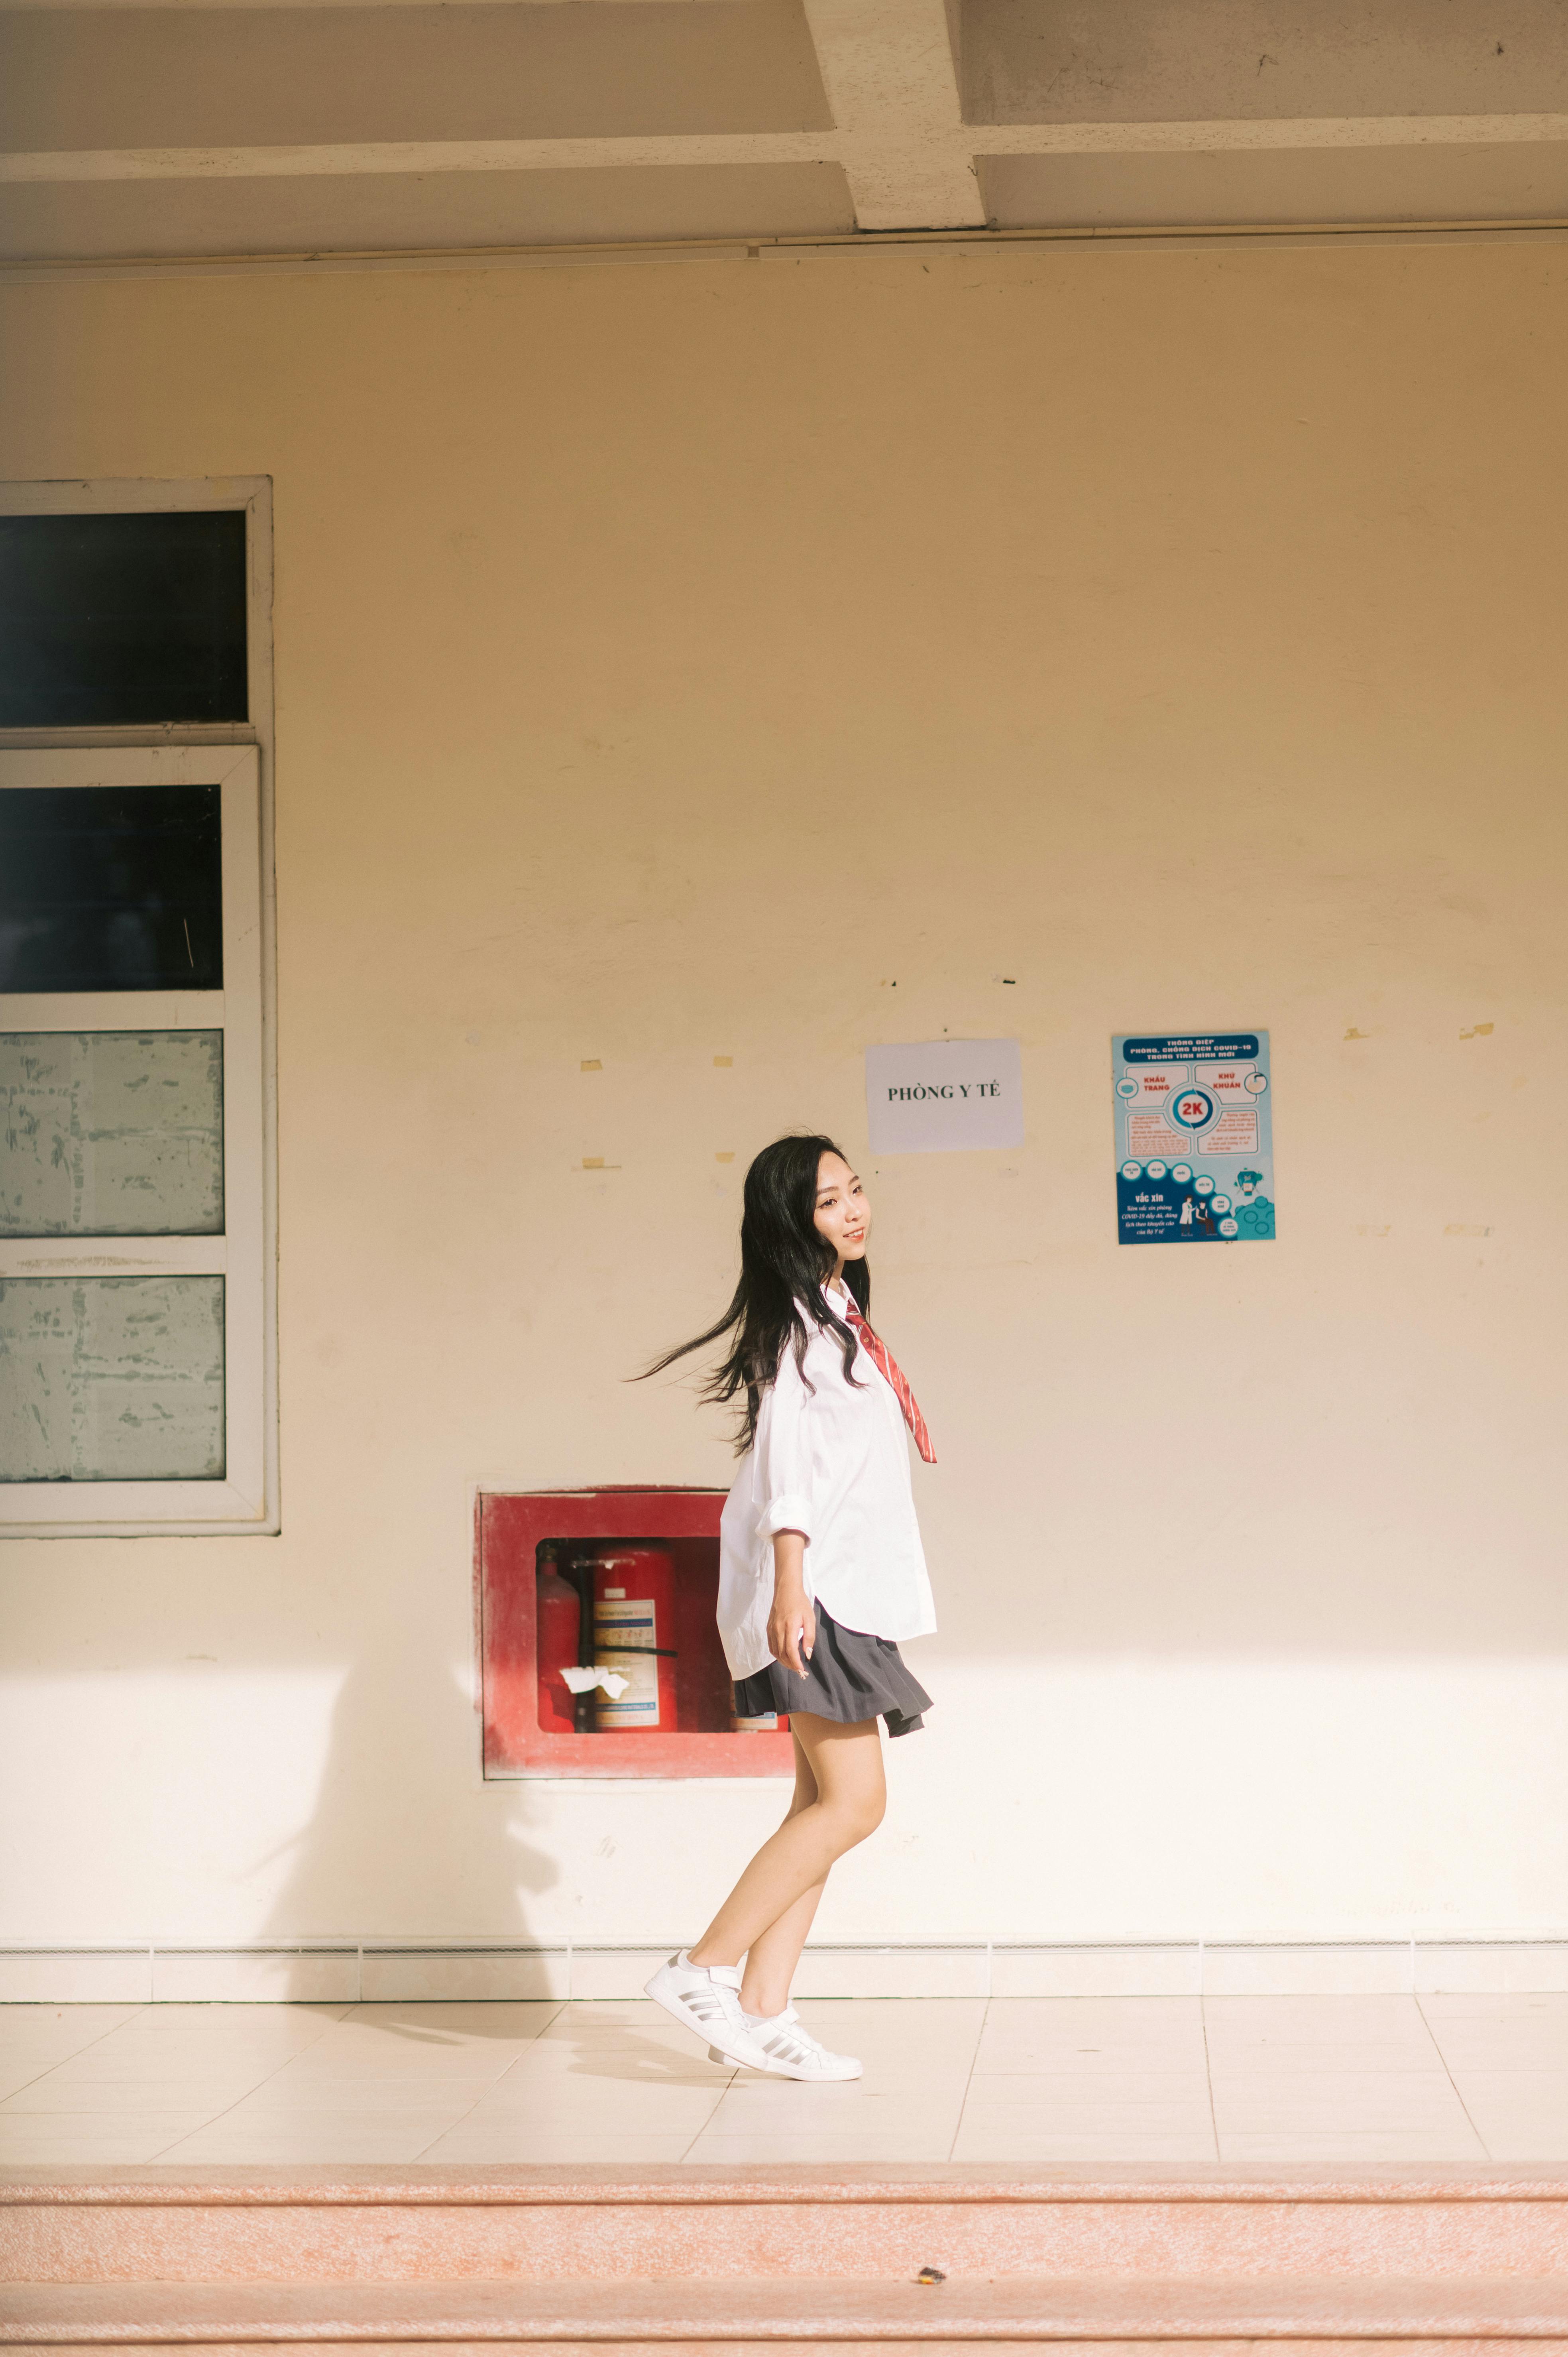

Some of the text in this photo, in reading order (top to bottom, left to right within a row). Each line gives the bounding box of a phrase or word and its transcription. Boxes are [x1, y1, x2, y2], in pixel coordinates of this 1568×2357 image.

[888, 1079, 1001, 1101] PHÒNG Y TẾ
[1183, 1103, 1203, 1116] 2K
[1135, 1192, 1163, 1203] vắc xin
